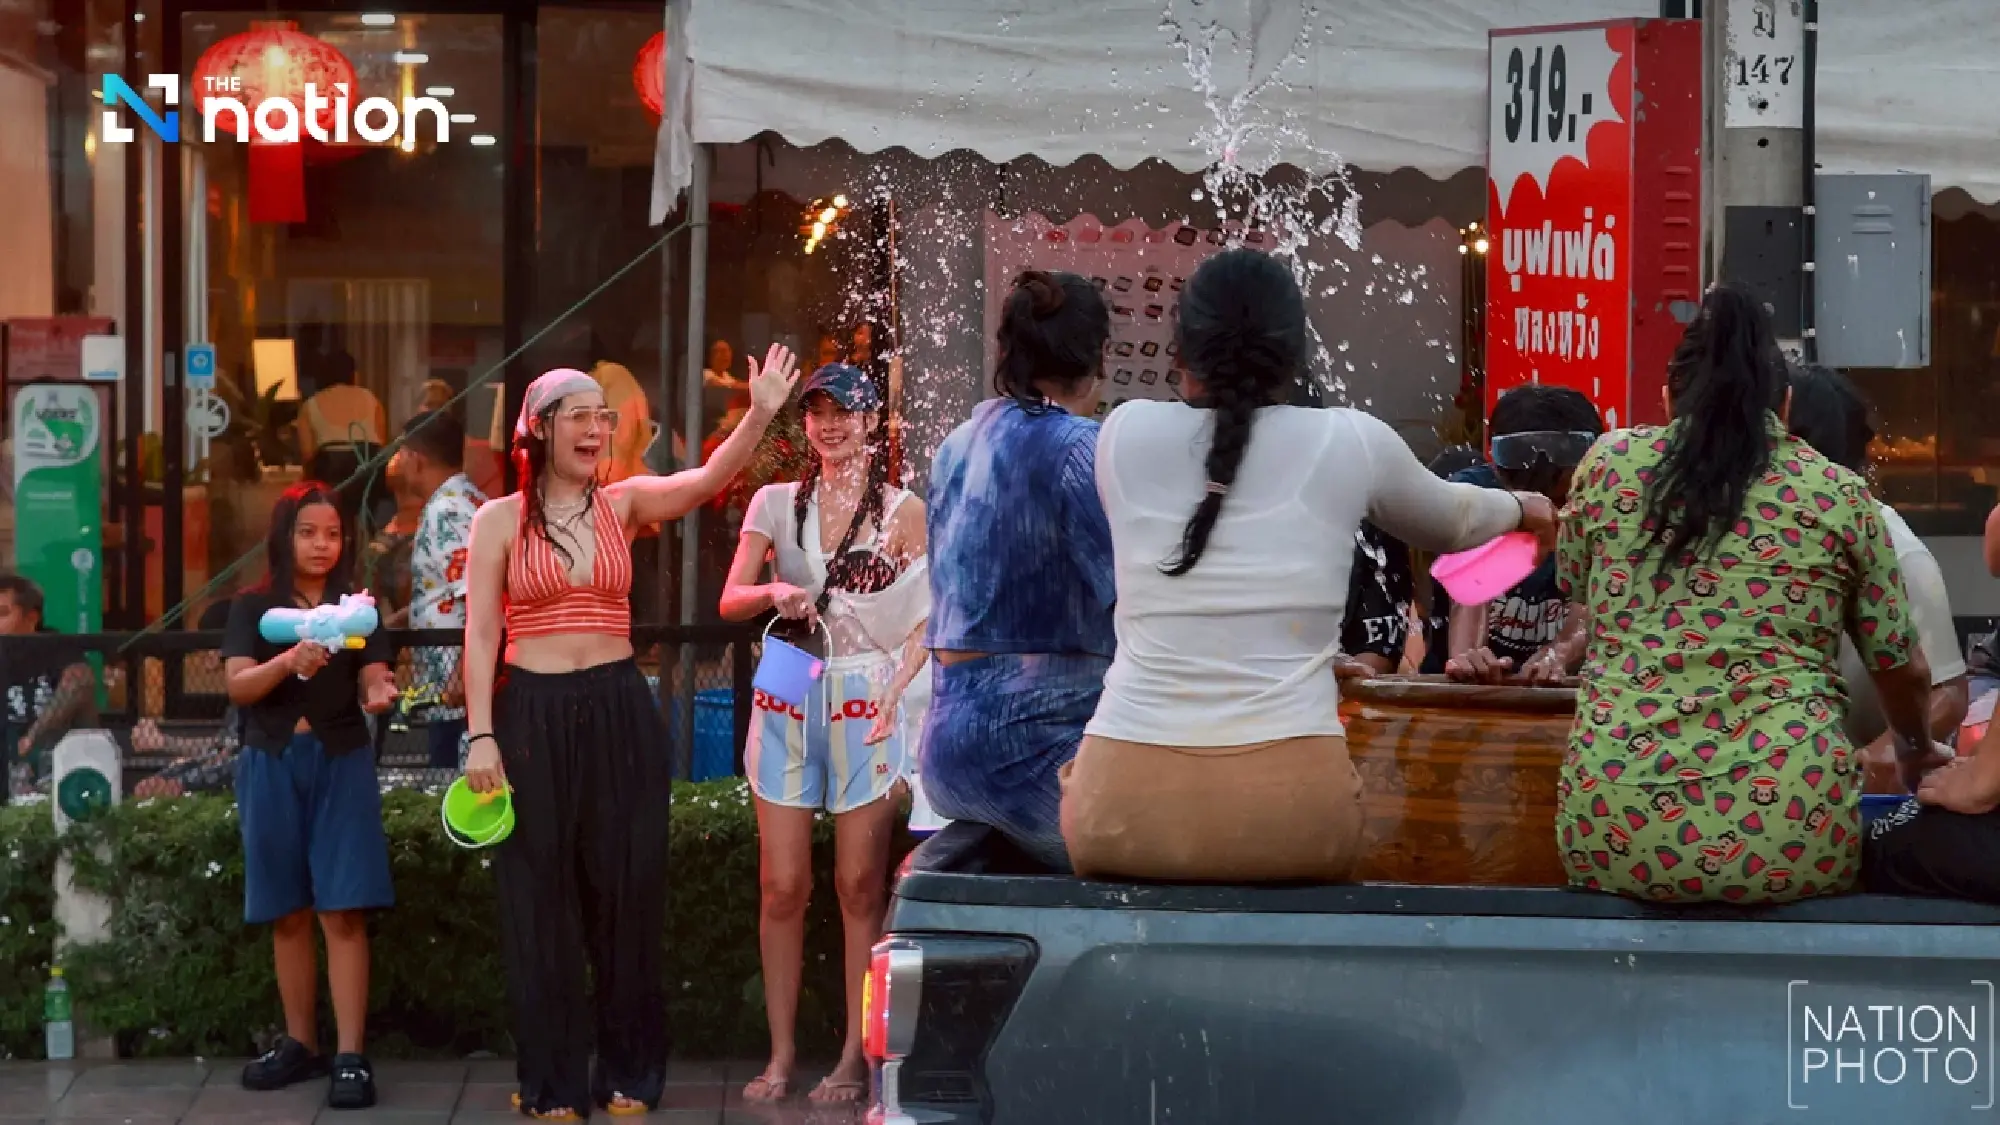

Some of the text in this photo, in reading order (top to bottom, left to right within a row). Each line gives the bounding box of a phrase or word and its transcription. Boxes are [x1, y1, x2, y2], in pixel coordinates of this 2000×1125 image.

[1505, 44, 1593, 143] 319.-
[1735, 54, 1795, 86] 147
[1502, 206, 1616, 292] บุฟเฟ่ต์
